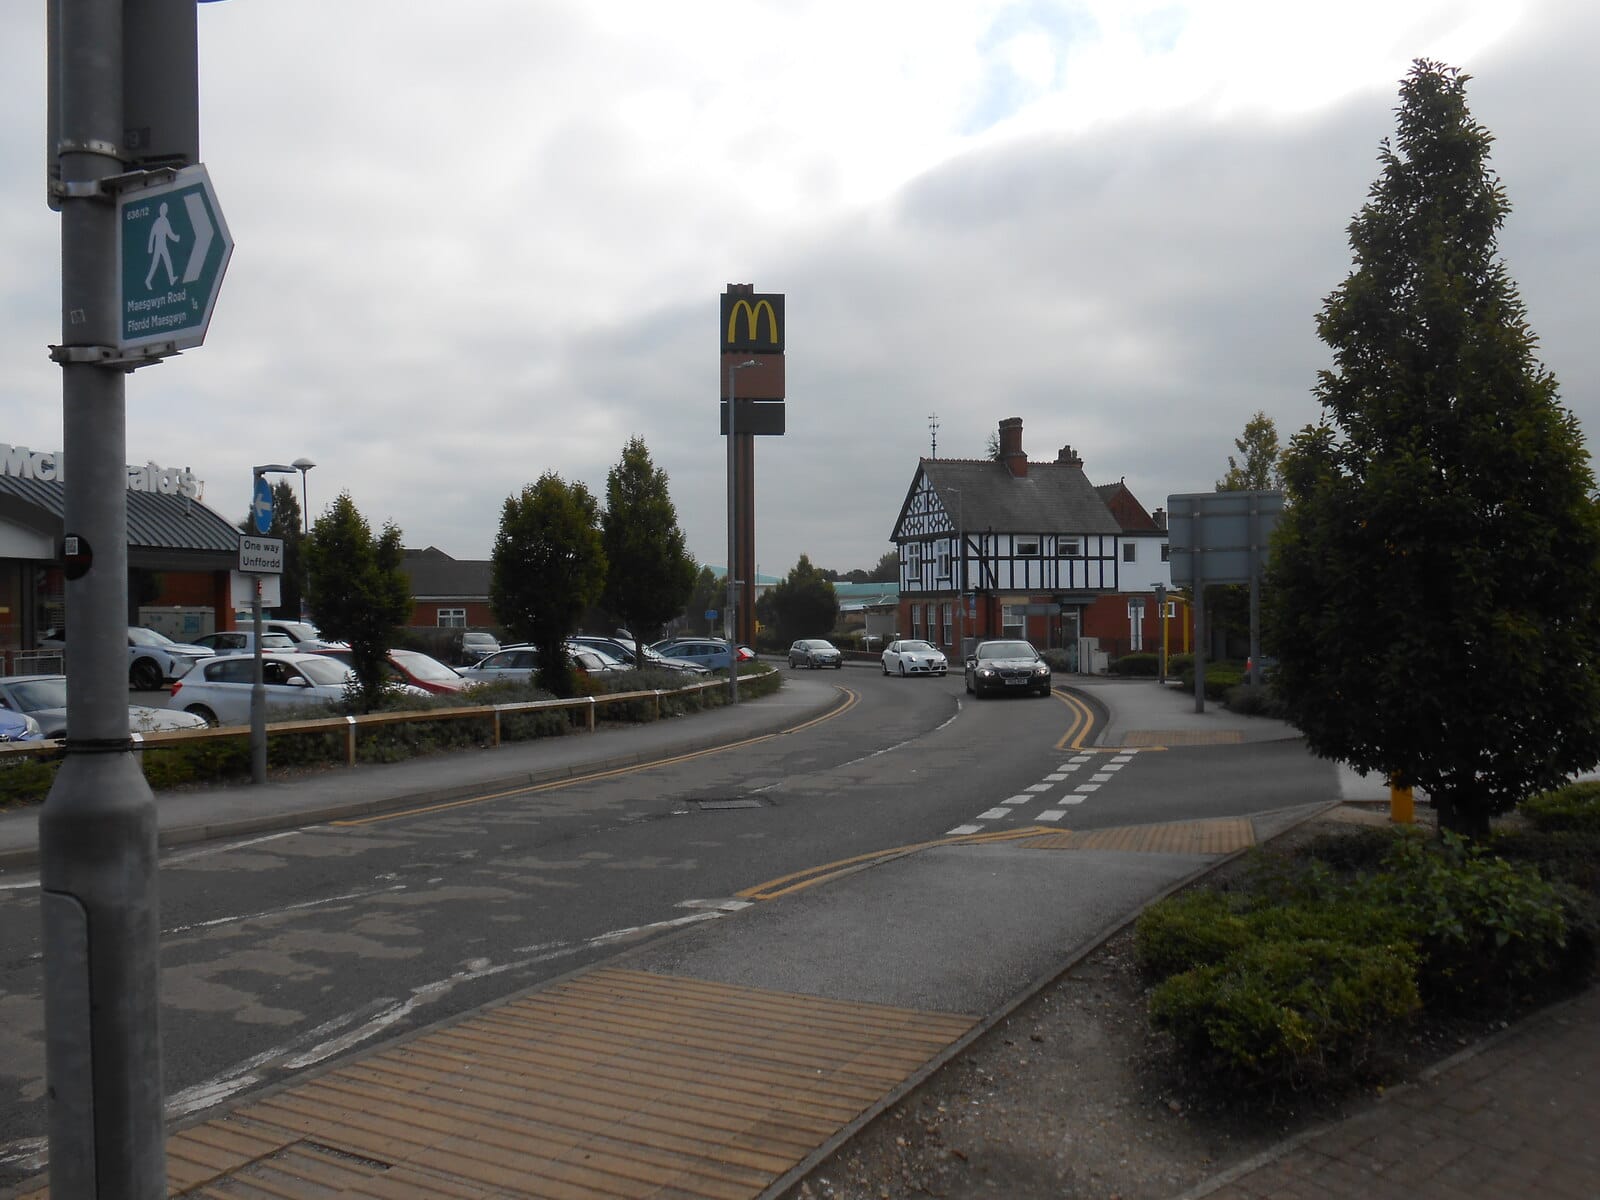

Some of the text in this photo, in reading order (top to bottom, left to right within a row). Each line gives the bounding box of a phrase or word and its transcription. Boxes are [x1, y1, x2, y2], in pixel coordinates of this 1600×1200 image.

[127, 296, 166, 312] Maesgwyn
[167, 288, 187, 304] Road
[127, 312, 187, 332] Ffordd Maesgwyn
[0, 443, 197, 498] Mcald's
[244, 540, 280, 554] One way
[243, 556, 281, 568] Unffordd
